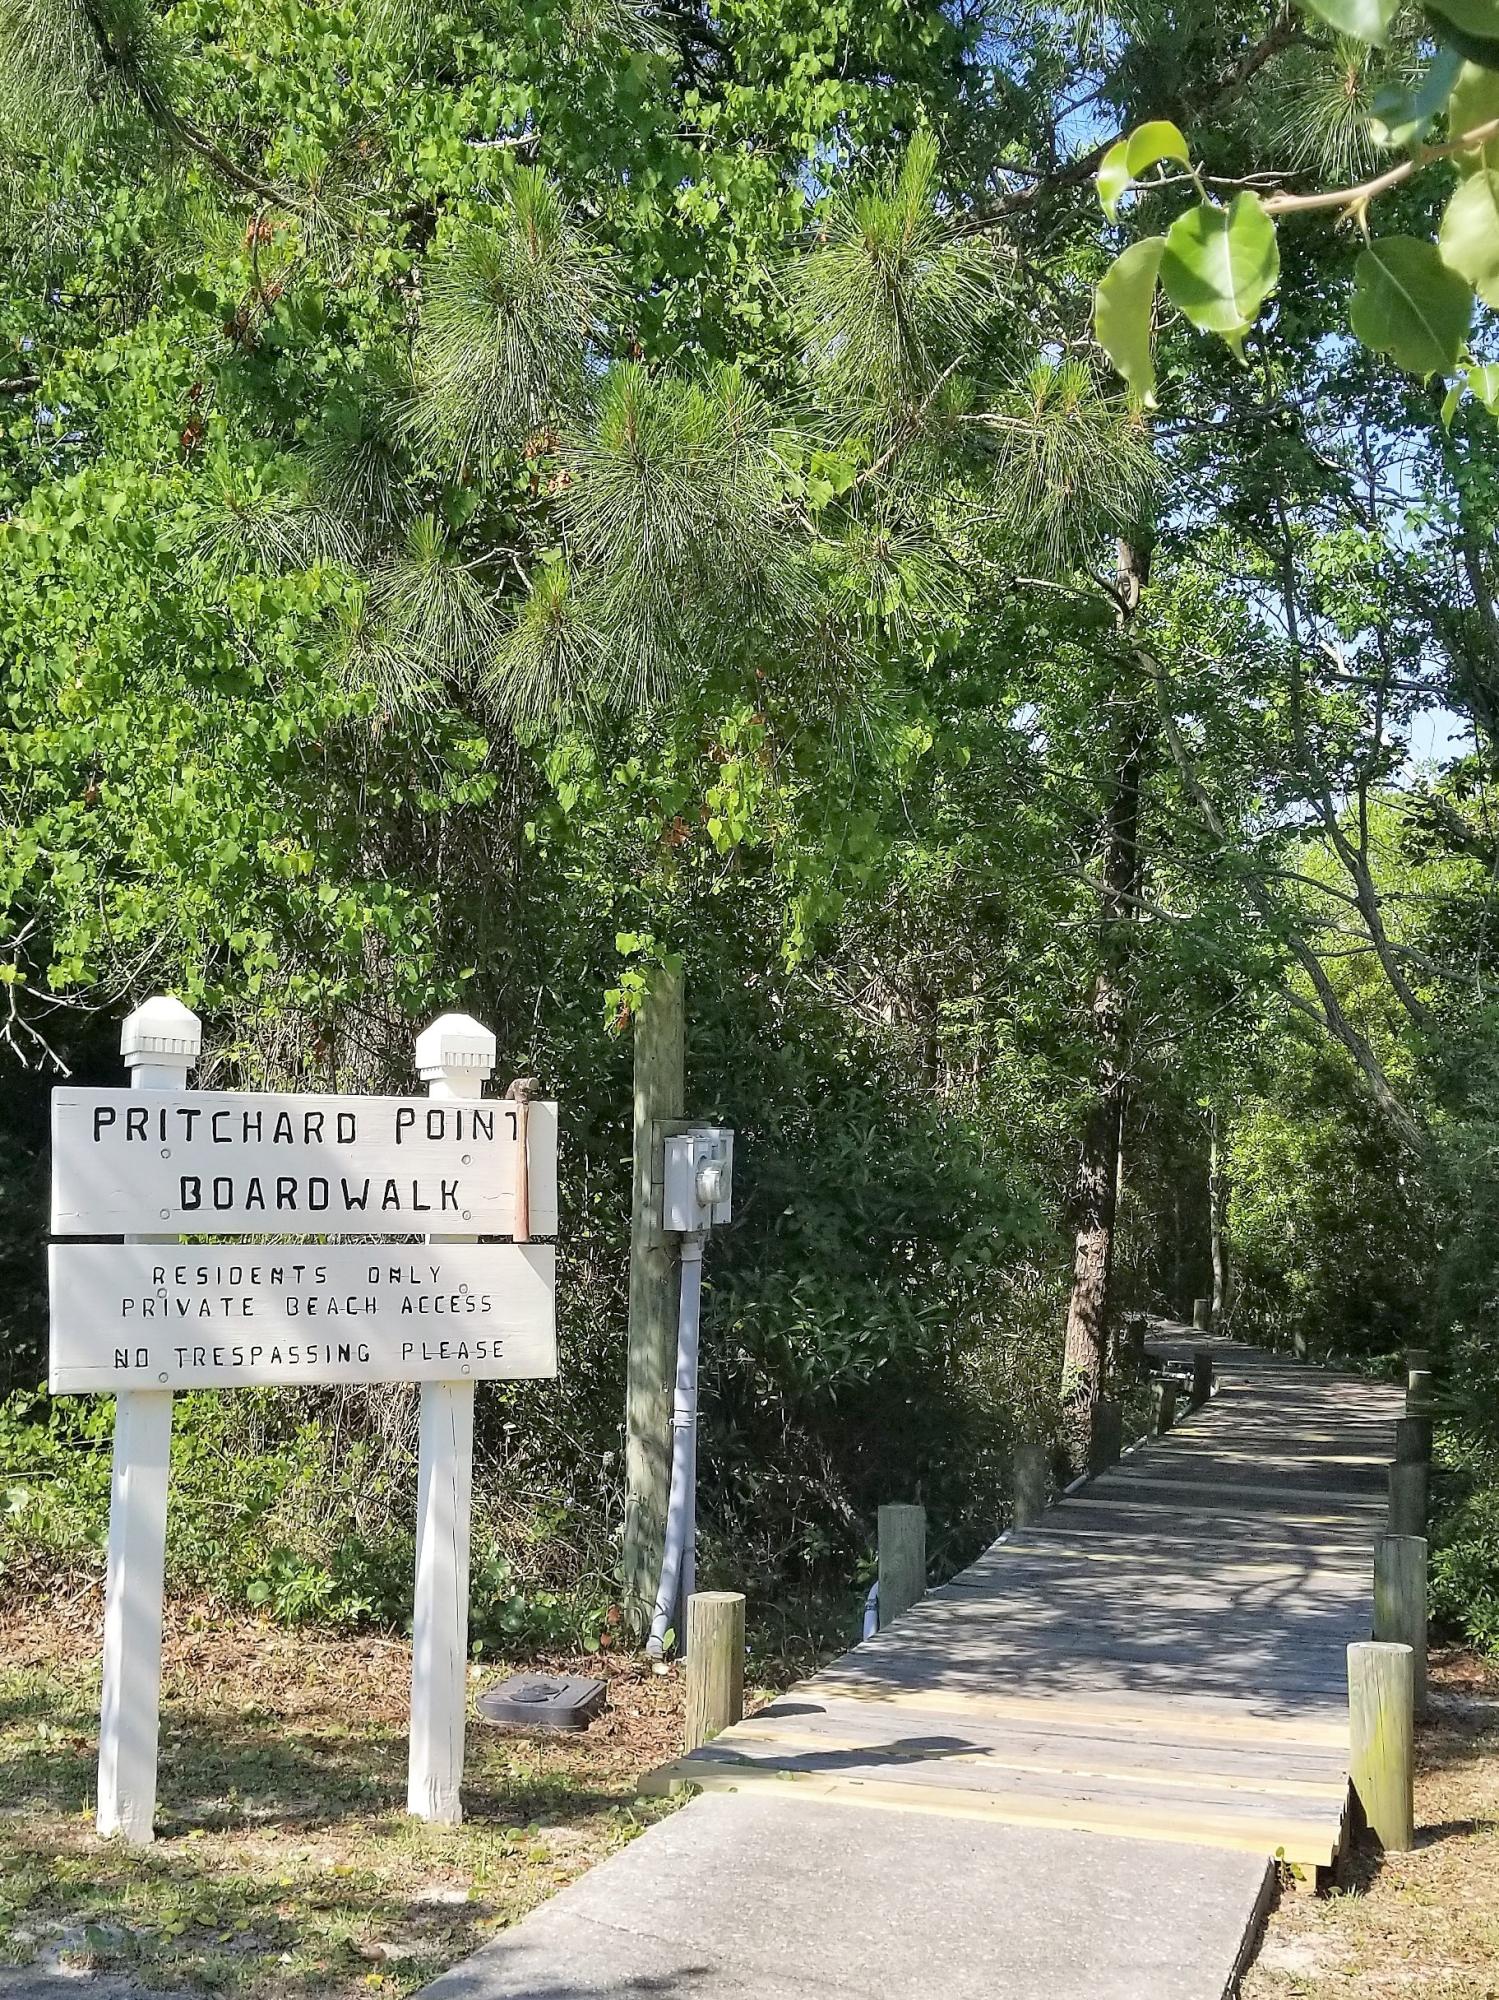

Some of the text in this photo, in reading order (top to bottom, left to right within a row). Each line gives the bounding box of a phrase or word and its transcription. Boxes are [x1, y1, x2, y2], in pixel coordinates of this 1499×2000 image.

[93, 1106, 357, 1144] PRITCHARD
[180, 1176, 460, 1211] BOARDWALK
[153, 1265, 441, 1285] RESIDENTS ONLY
[122, 1295, 492, 1317] PRIVATE BEACH ACCESS
[114, 1340, 504, 1369] NO TRESPASSING PLEASE
